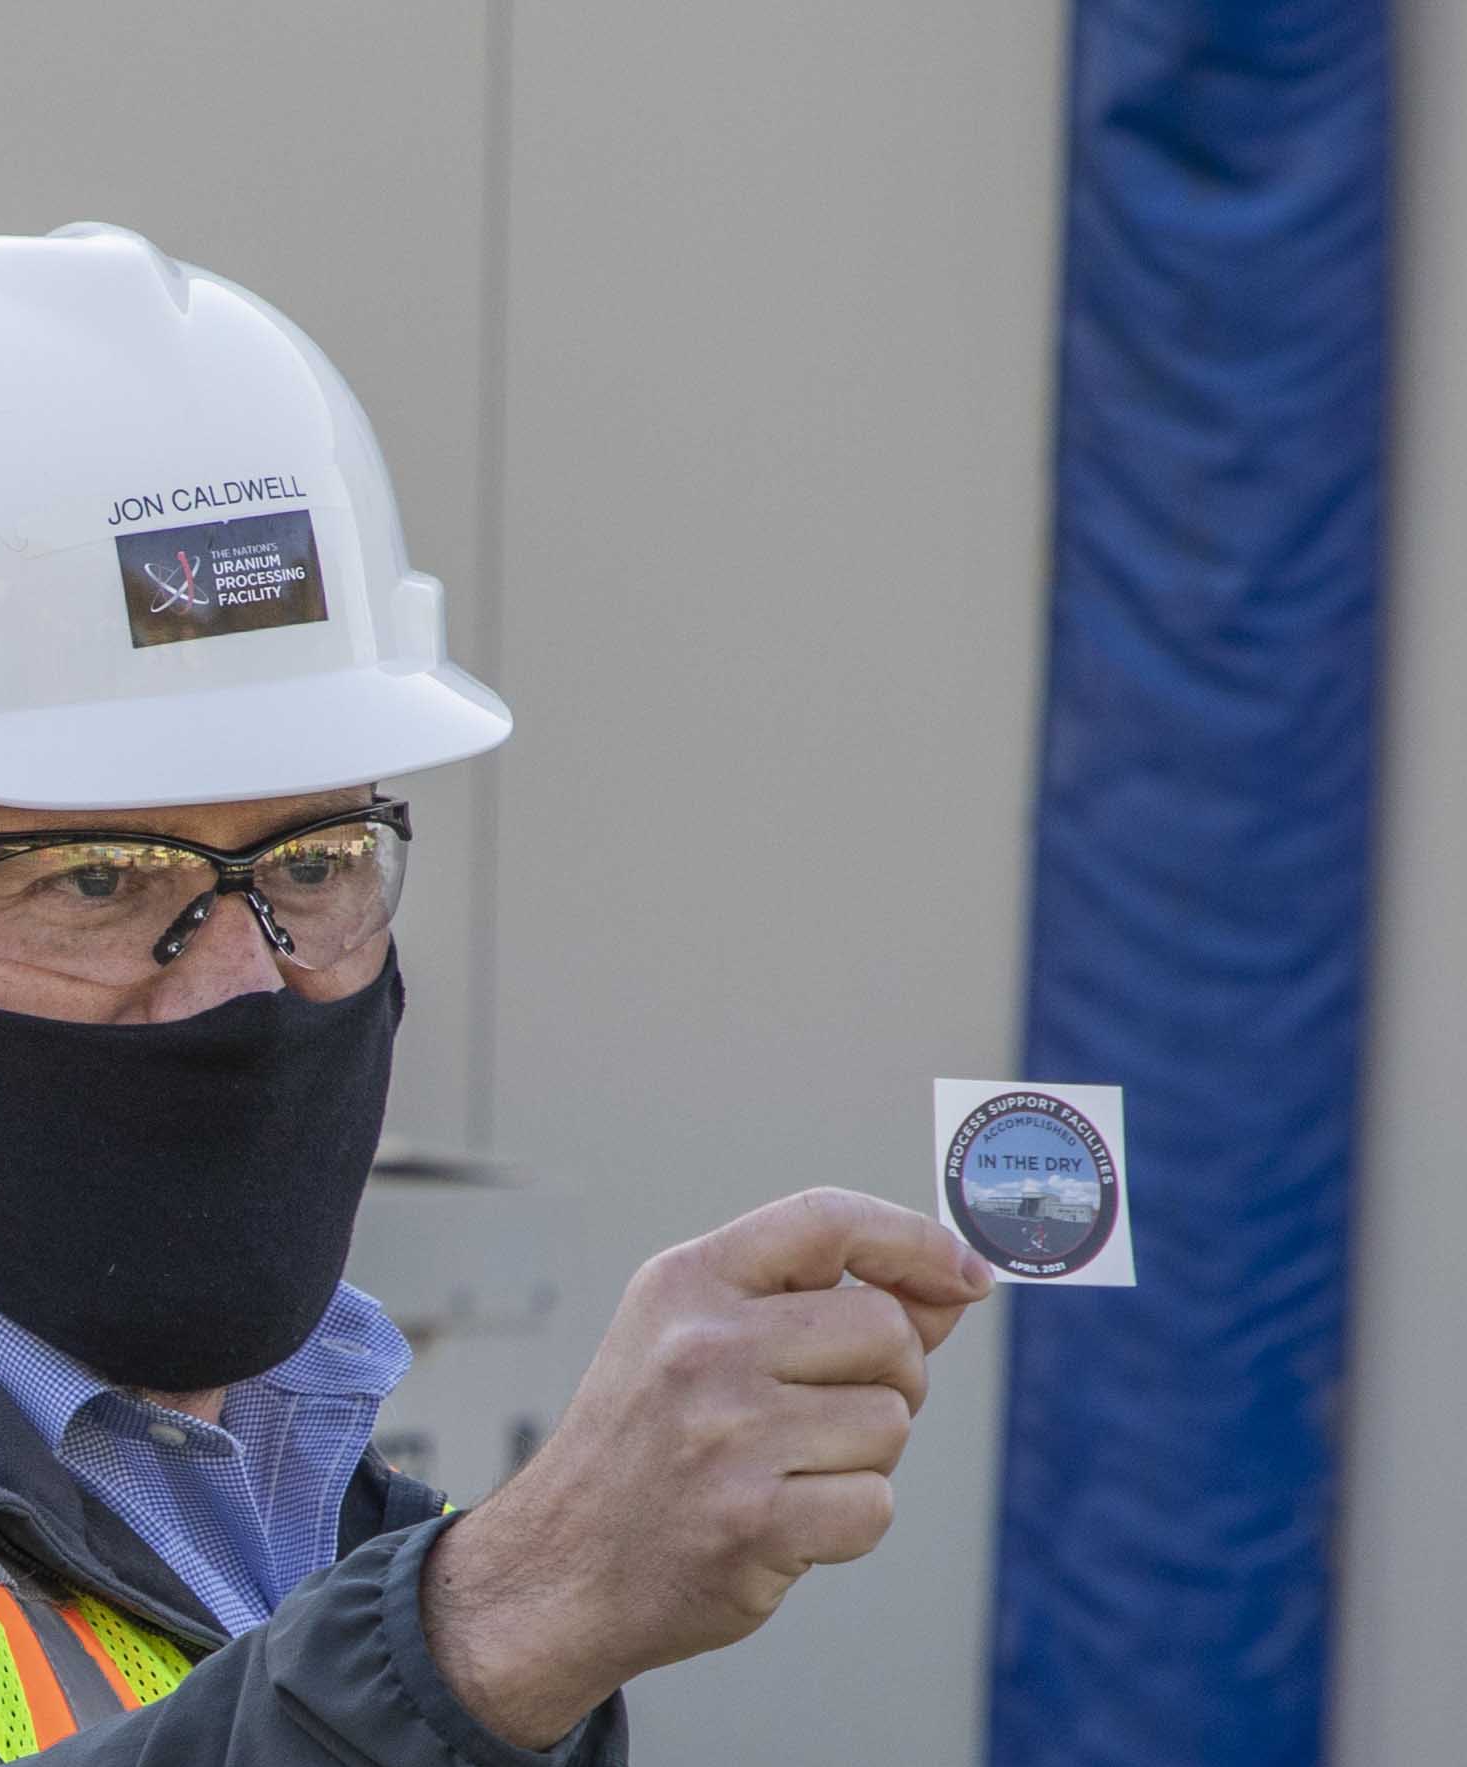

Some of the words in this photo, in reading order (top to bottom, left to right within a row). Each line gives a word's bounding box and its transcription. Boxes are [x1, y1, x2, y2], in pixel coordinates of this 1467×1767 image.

[108, 493, 165, 525] JON
[172, 476, 306, 512] CALDWELL
[211, 549, 231, 559] THE
[212, 554, 281, 575] URANIUM
[215, 566, 306, 590] PROCESSING
[218, 586, 281, 606] FACILITY
[948, 1112, 988, 1178] PROCESS
[988, 1096, 1059, 1116] SUPPORT
[1061, 1109, 1114, 1185] FACILITIES
[983, 1116, 1077, 1146] ACCOMPLISHED
[978, 1154, 996, 1168] IN
[1002, 1155, 1039, 1170] THE
[1045, 1156, 1082, 1172] DRY
[1008, 1260, 1040, 1273] APRIL
